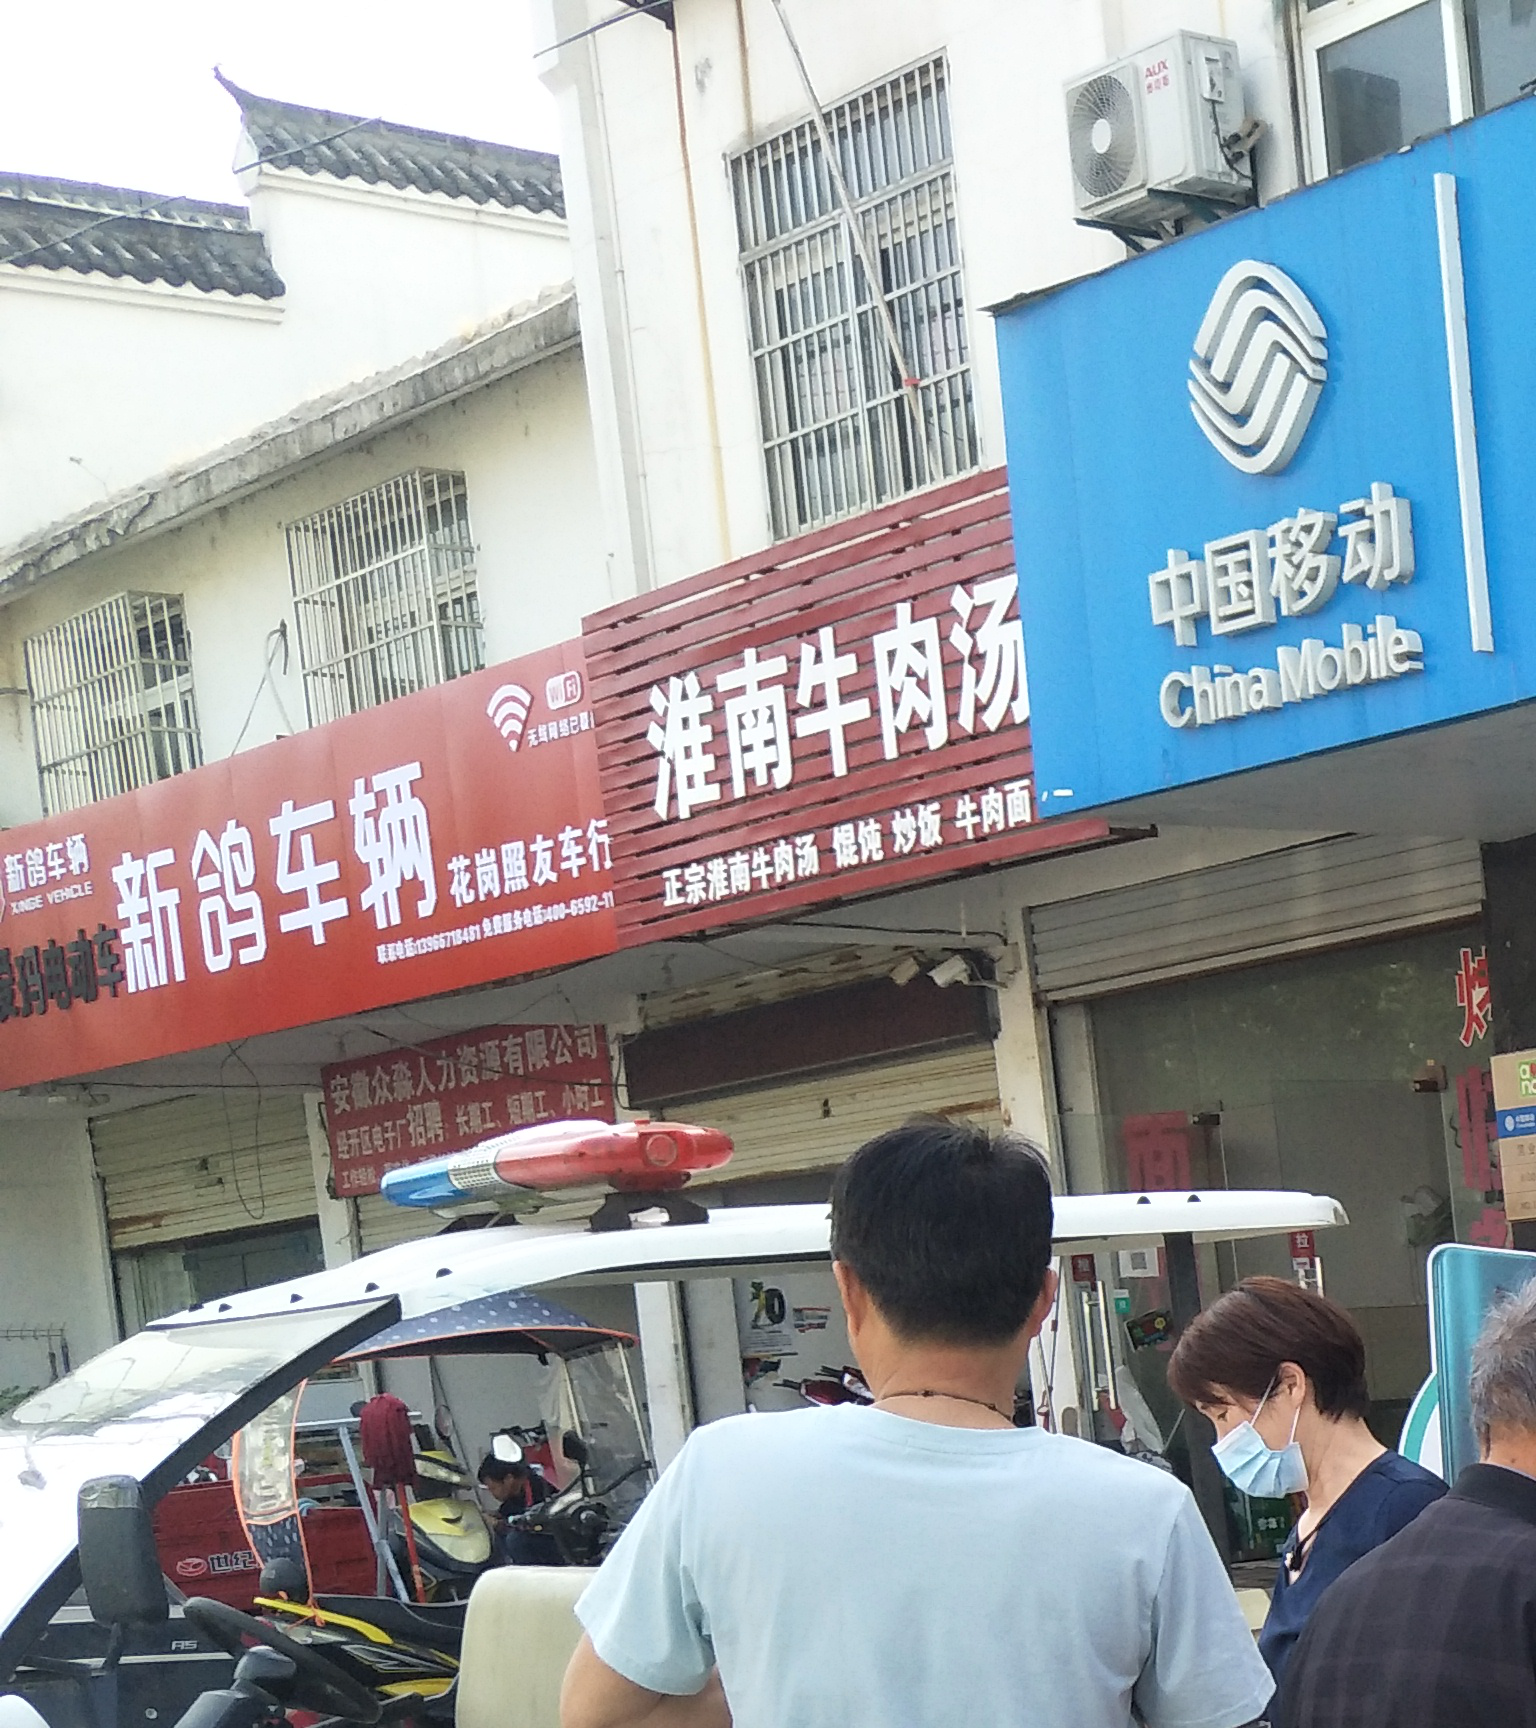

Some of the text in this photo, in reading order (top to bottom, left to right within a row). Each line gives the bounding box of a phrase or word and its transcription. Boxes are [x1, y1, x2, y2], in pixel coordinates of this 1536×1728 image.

[1148, 481, 1415, 647] 中国移动
[646, 574, 1030, 822] 淮南牛肉汤
[1159, 614, 1424, 730] China Mobile
[4, 833, 90, 893] 新鸽车辆
[111, 761, 437, 993] 新鸽车辆
[447, 818, 614, 908] 花岗照友车行
[662, 778, 1033, 907] 正宗淮南牛肉汤 馄饨 炒饭 牛肉面
